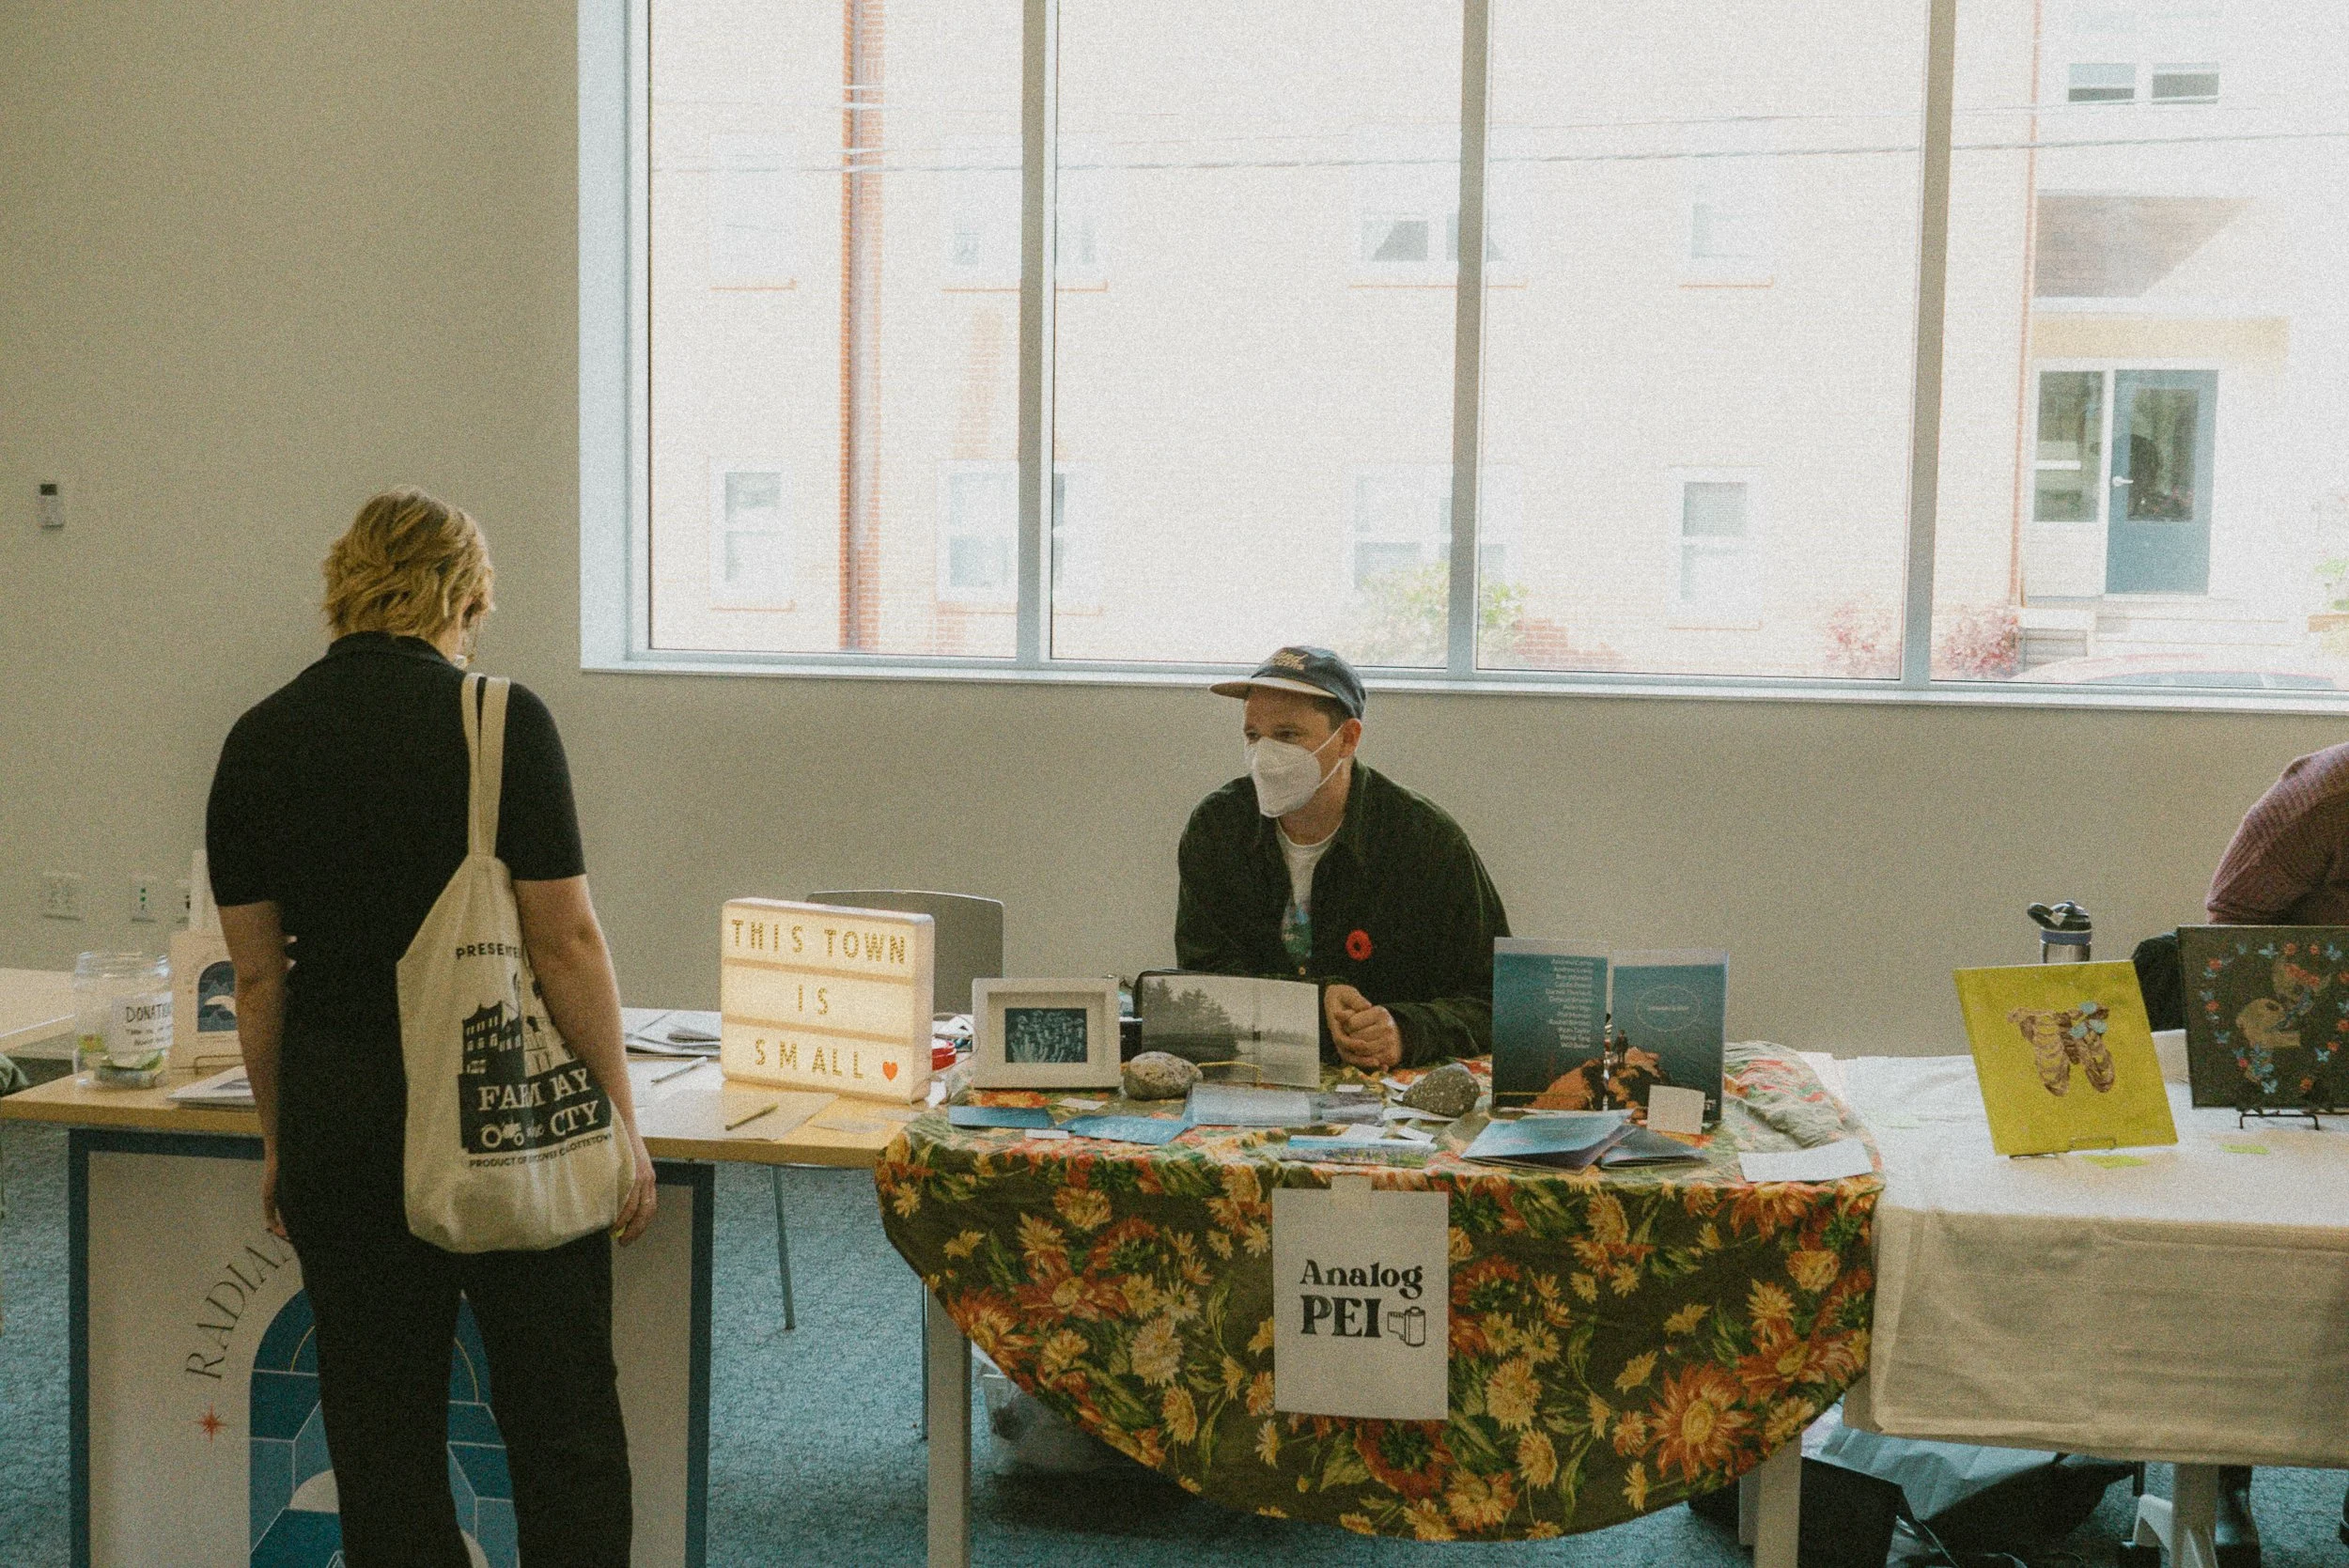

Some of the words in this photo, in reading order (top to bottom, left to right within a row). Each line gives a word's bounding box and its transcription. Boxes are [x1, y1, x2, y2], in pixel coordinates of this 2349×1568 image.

[732, 919, 803, 954] THIS
[824, 927, 906, 965] TOWN
[798, 983, 829, 1016] IS
[754, 1038, 864, 1079] SMALL
[550, 1099, 600, 1137] CTY
[470, 1157, 516, 1168] PRODUCT
[1299, 1258, 1423, 1300] Analog
[1299, 1294, 1382, 1339] PEI
